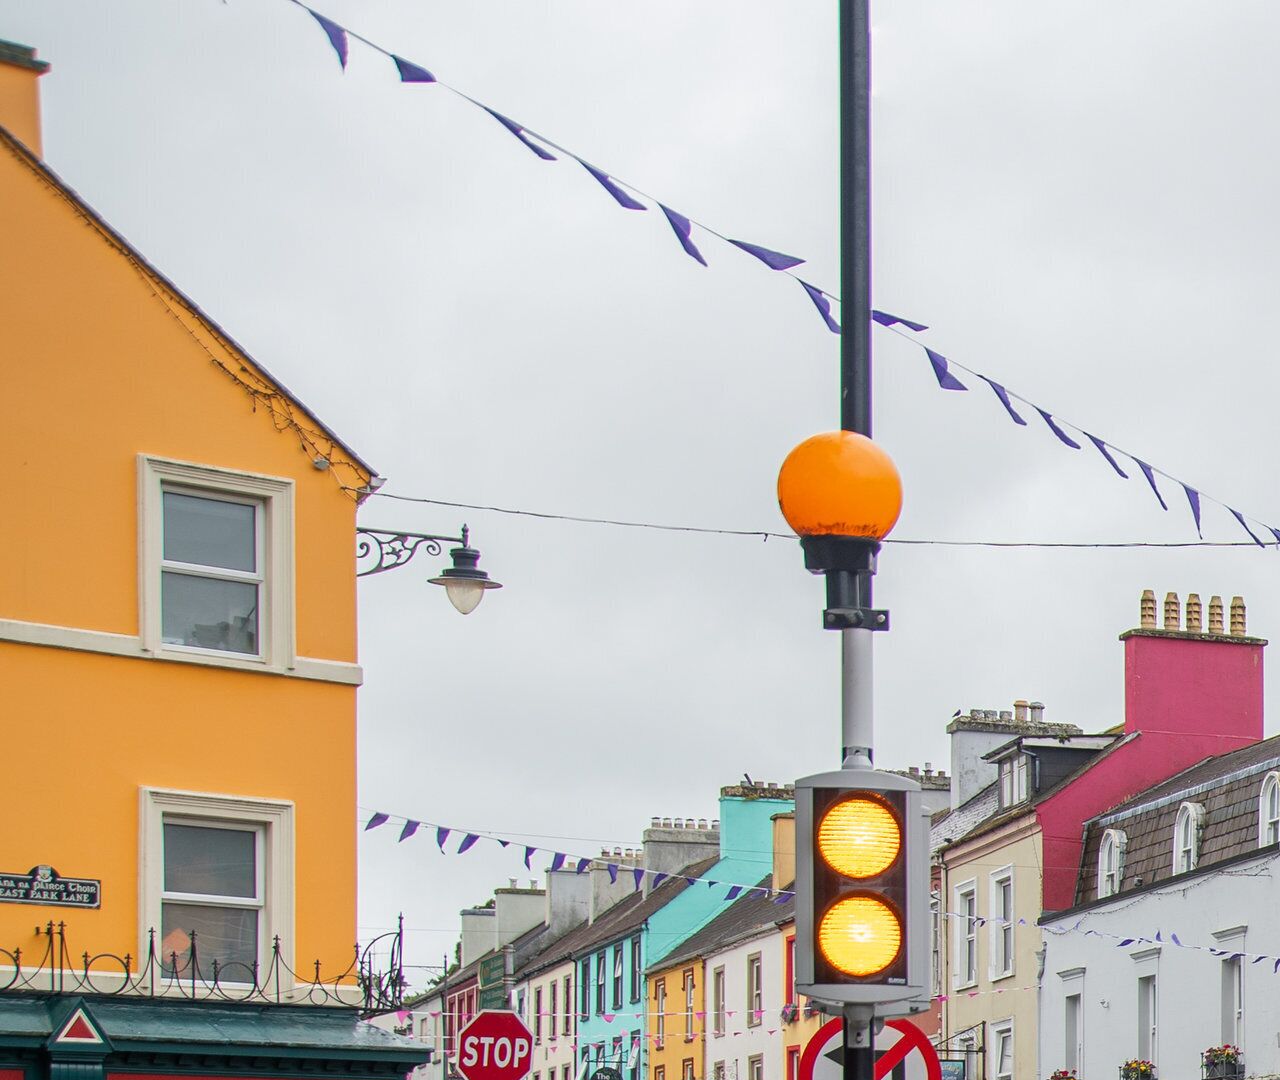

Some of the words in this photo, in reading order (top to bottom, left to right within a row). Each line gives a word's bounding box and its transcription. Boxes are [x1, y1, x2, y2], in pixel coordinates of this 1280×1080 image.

[30, 890, 59, 901] PARK
[62, 892, 90, 903] LANE
[462, 1036, 529, 1068] STOP
[596, 1072, 610, 1080] The
